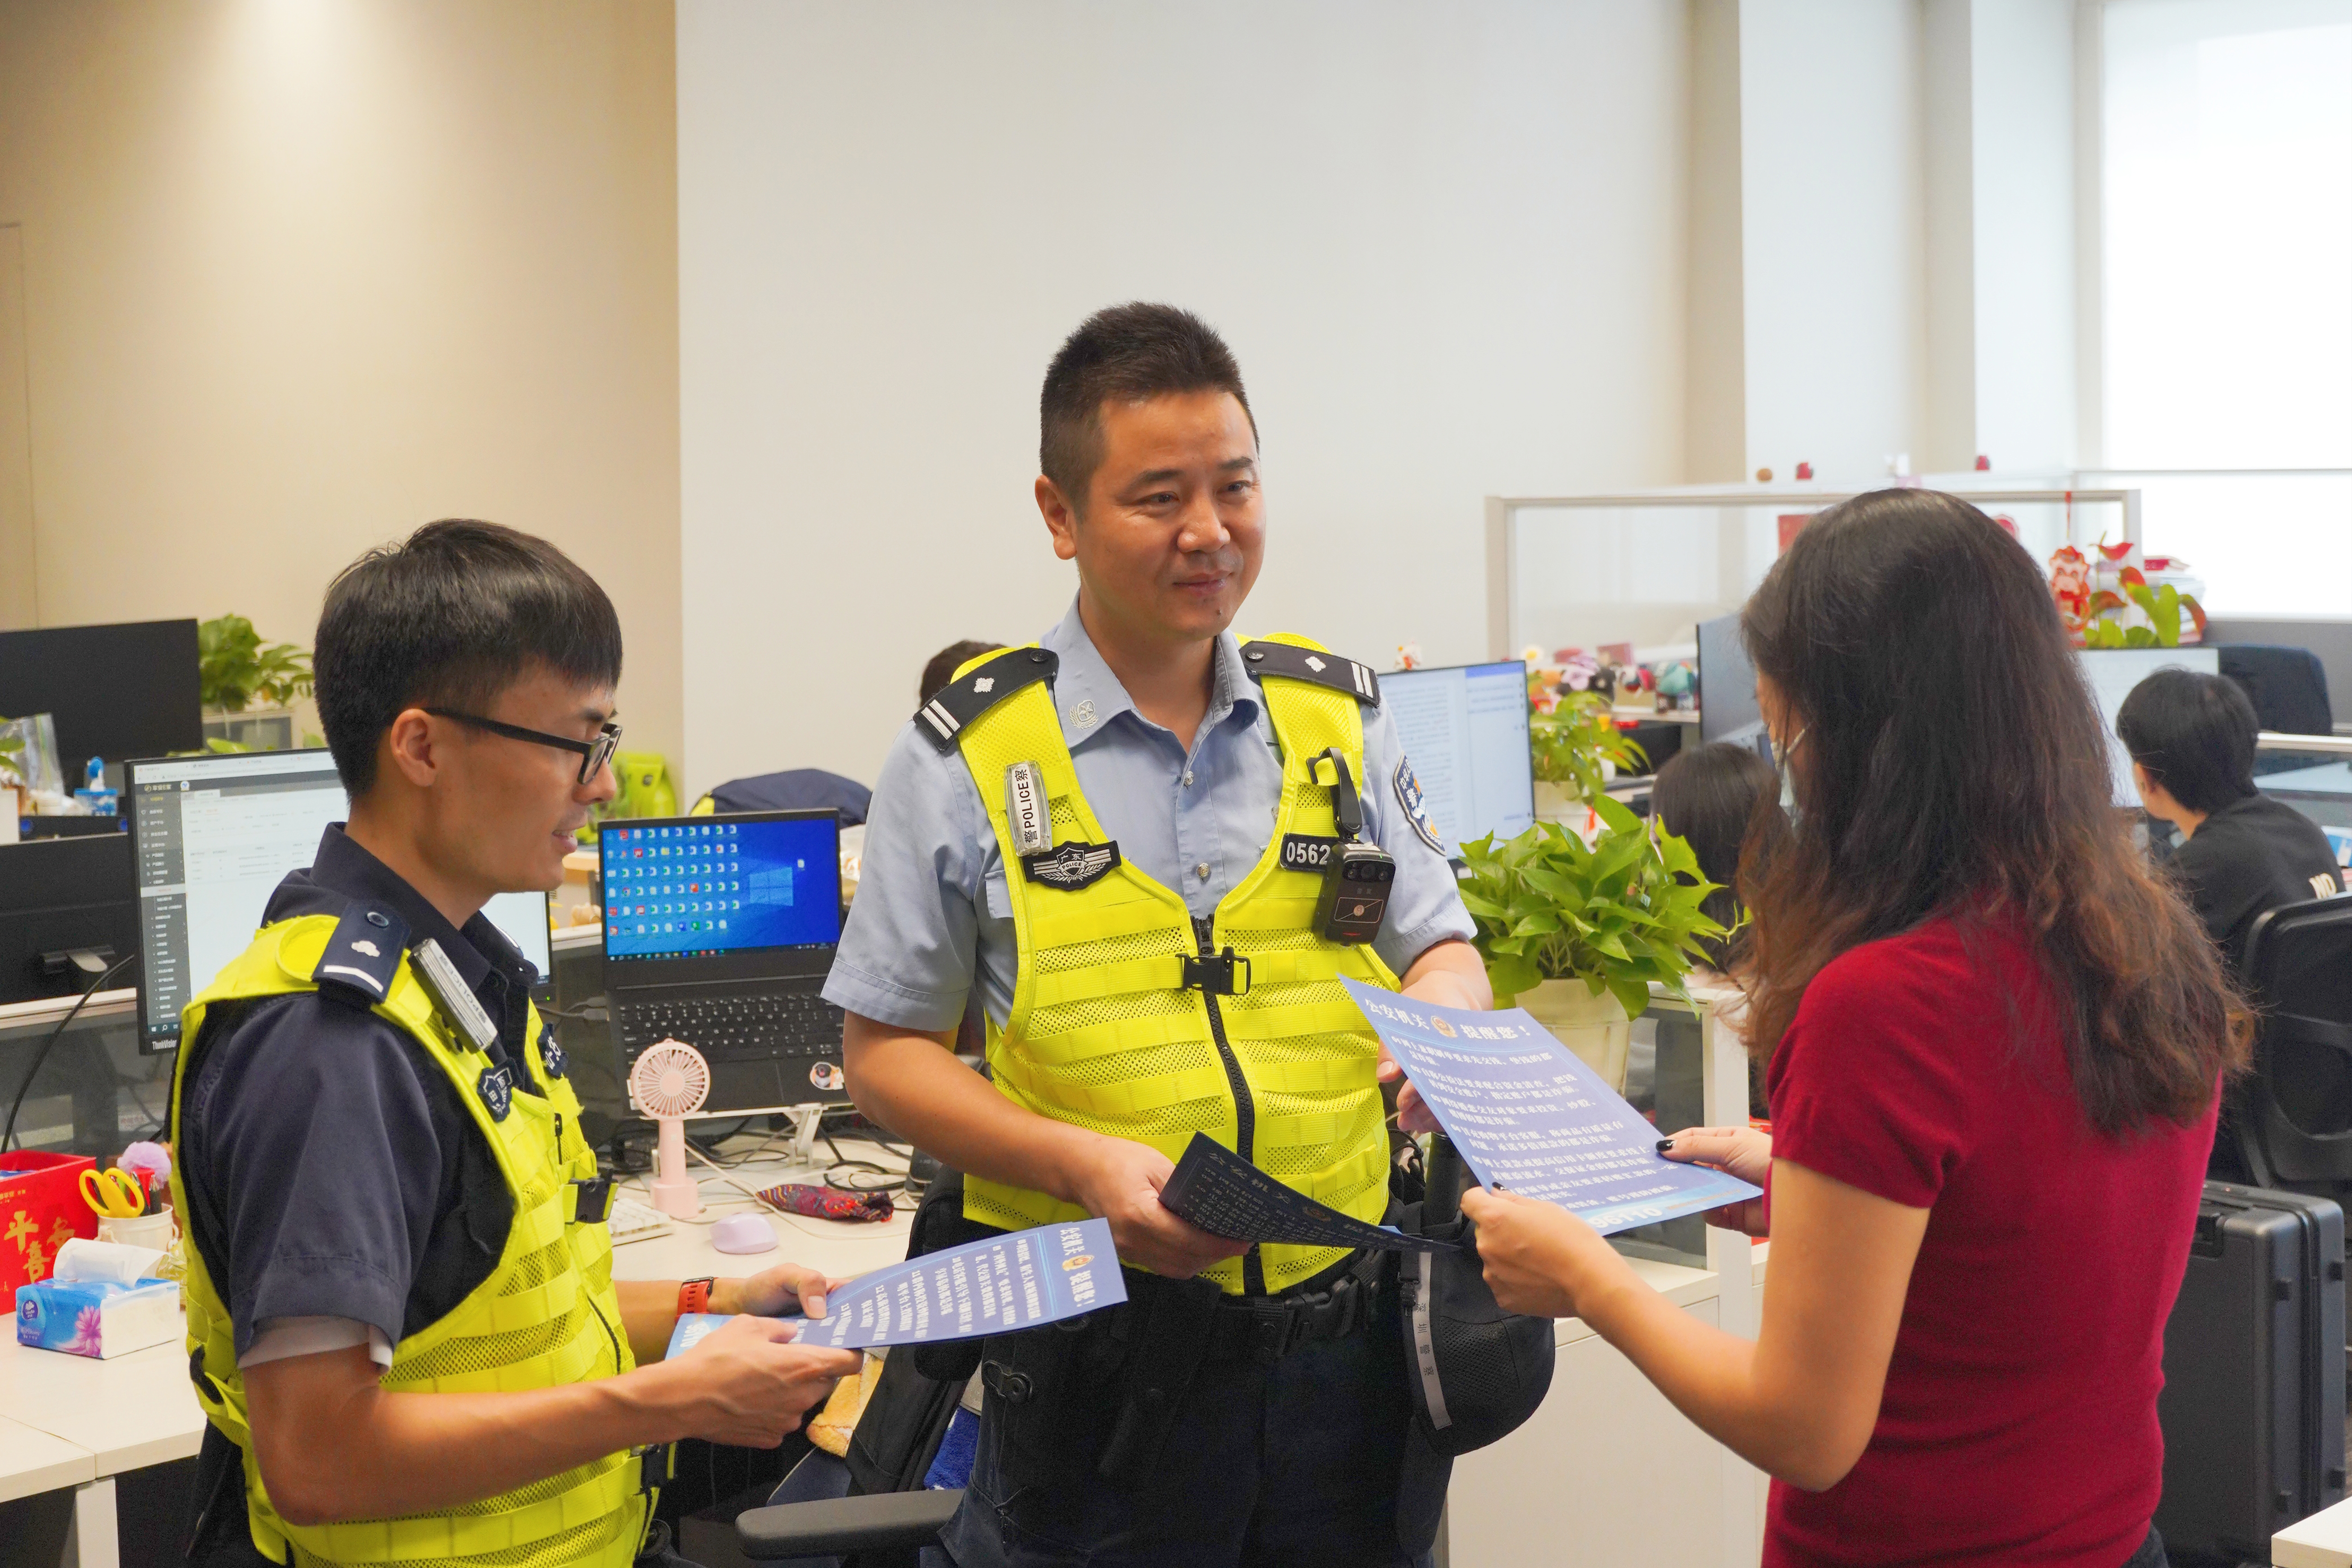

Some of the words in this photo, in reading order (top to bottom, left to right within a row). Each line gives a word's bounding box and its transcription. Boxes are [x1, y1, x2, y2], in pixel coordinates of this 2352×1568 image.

[1060, 852, 1082, 864] 广东
[1286, 841, 1331, 865] 0562
[1365, 998, 1430, 1030] 公安机关
[1459, 1023, 1531, 1041] 提醒您！
[1588, 1207, 1663, 1229] 96110
[1060, 1227, 1086, 1256] 公安机关
[1416, 1303, 1434, 1376] 深圳警察
